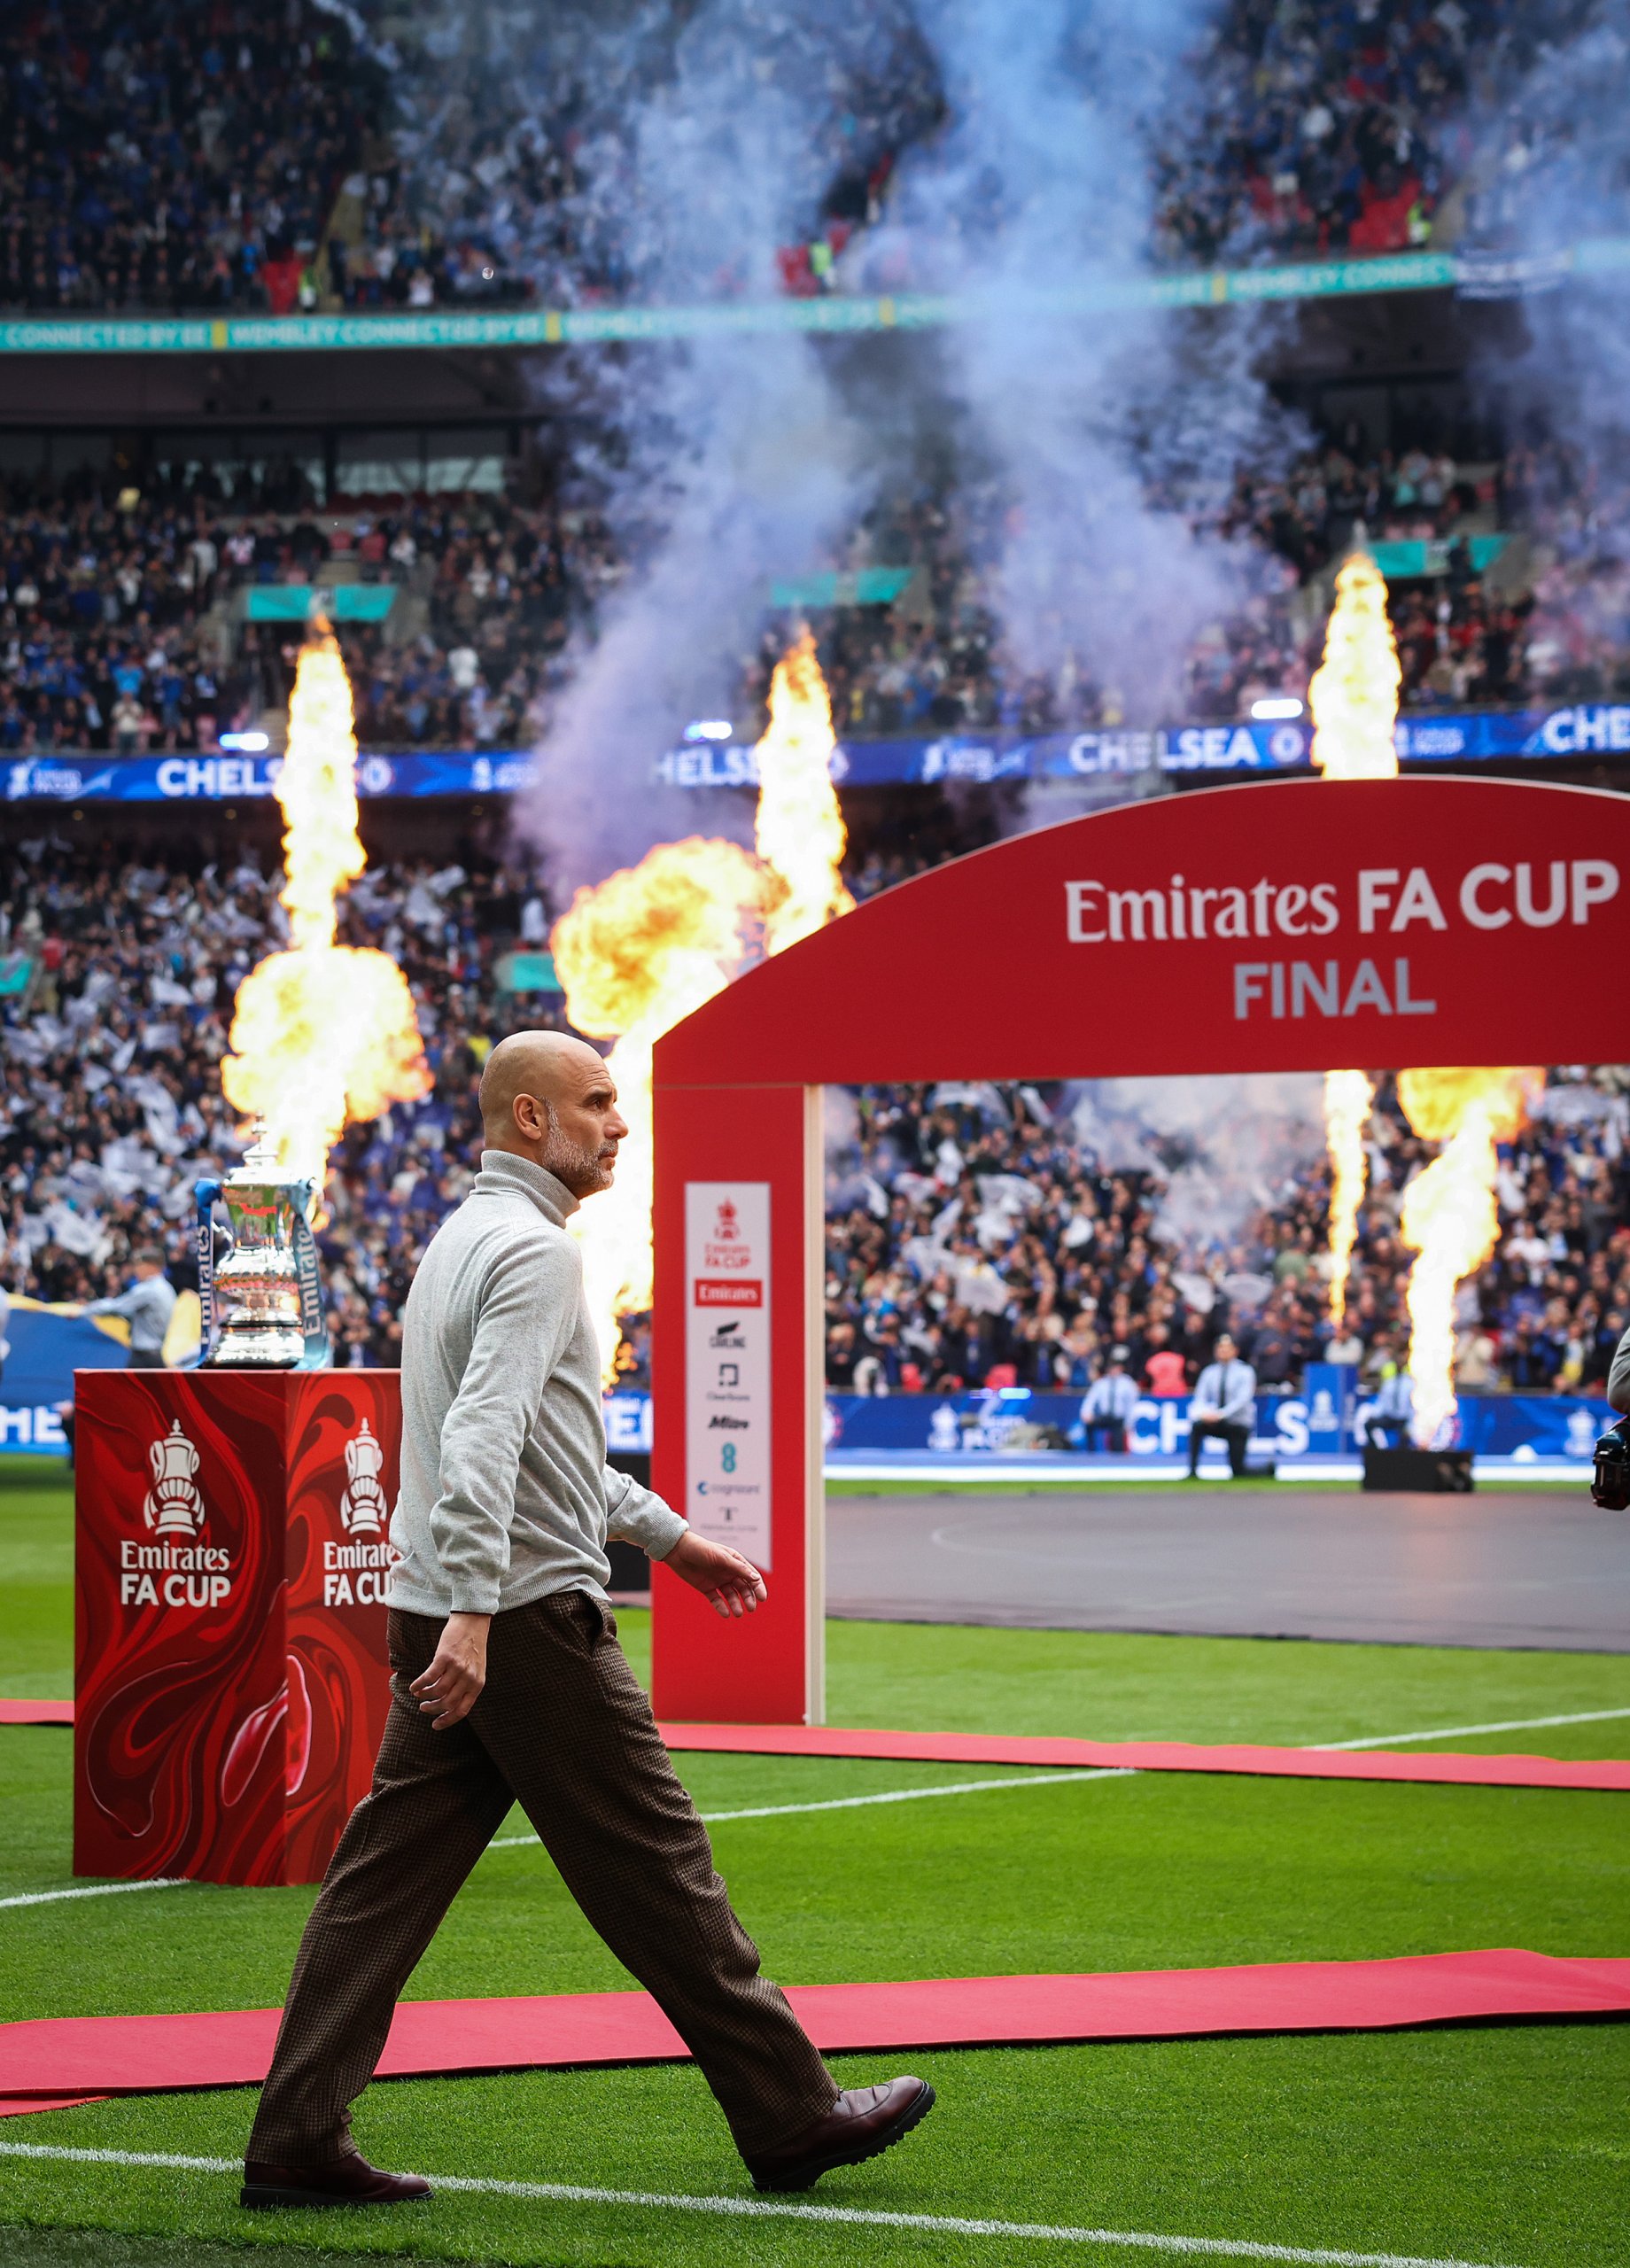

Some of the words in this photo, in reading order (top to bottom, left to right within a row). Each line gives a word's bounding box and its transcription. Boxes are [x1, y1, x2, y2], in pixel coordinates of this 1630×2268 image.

[5, 325, 145, 347] CONNECTED
[231, 321, 338, 345] WEMBLEY
[340, 318, 480, 344] CONNECTED
[1069, 727, 1260, 773] CHELSEA
[1066, 874, 1339, 944] Emirates
[1357, 867, 1448, 934] FA
[1459, 858, 1618, 930] CUP
[1233, 957, 1437, 1021] FINAL
[699, 1283, 759, 1303] Emirates
[120, 1539, 230, 1573] Emirates
[120, 1573, 159, 1606] FA
[163, 1573, 231, 1608] CUP
[323, 1573, 354, 1607] FA
[356, 1571, 395, 1604] CU
